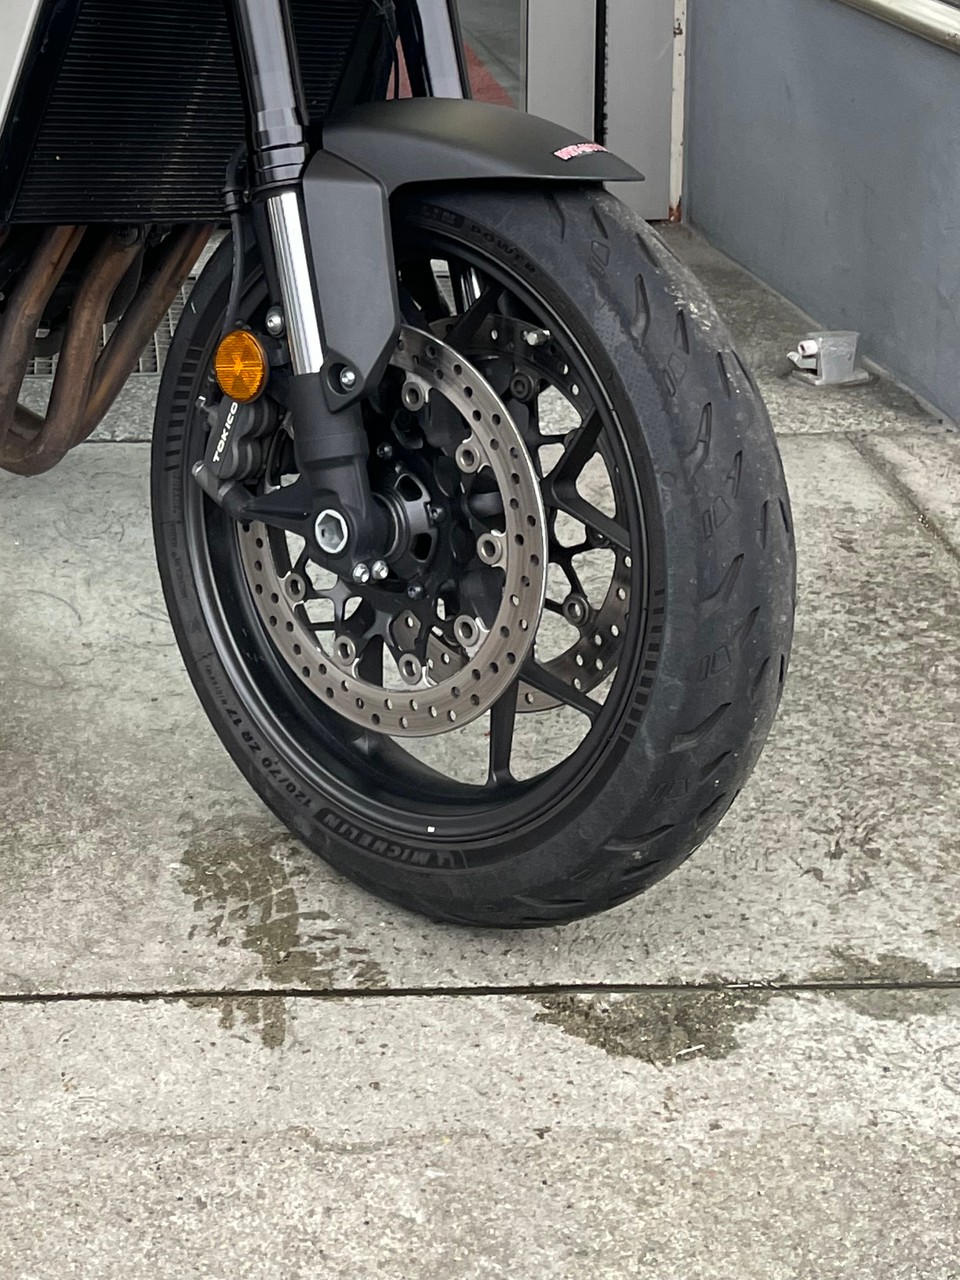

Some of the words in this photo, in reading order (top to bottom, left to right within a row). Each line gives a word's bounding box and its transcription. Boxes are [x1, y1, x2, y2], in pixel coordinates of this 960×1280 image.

[212, 401, 239, 463] TOKICO
[226, 708, 243, 728] 17
[241, 730, 260, 752] ZR
[262, 756, 312, 809] 120/70
[322, 813, 430, 867] MICHELIN
